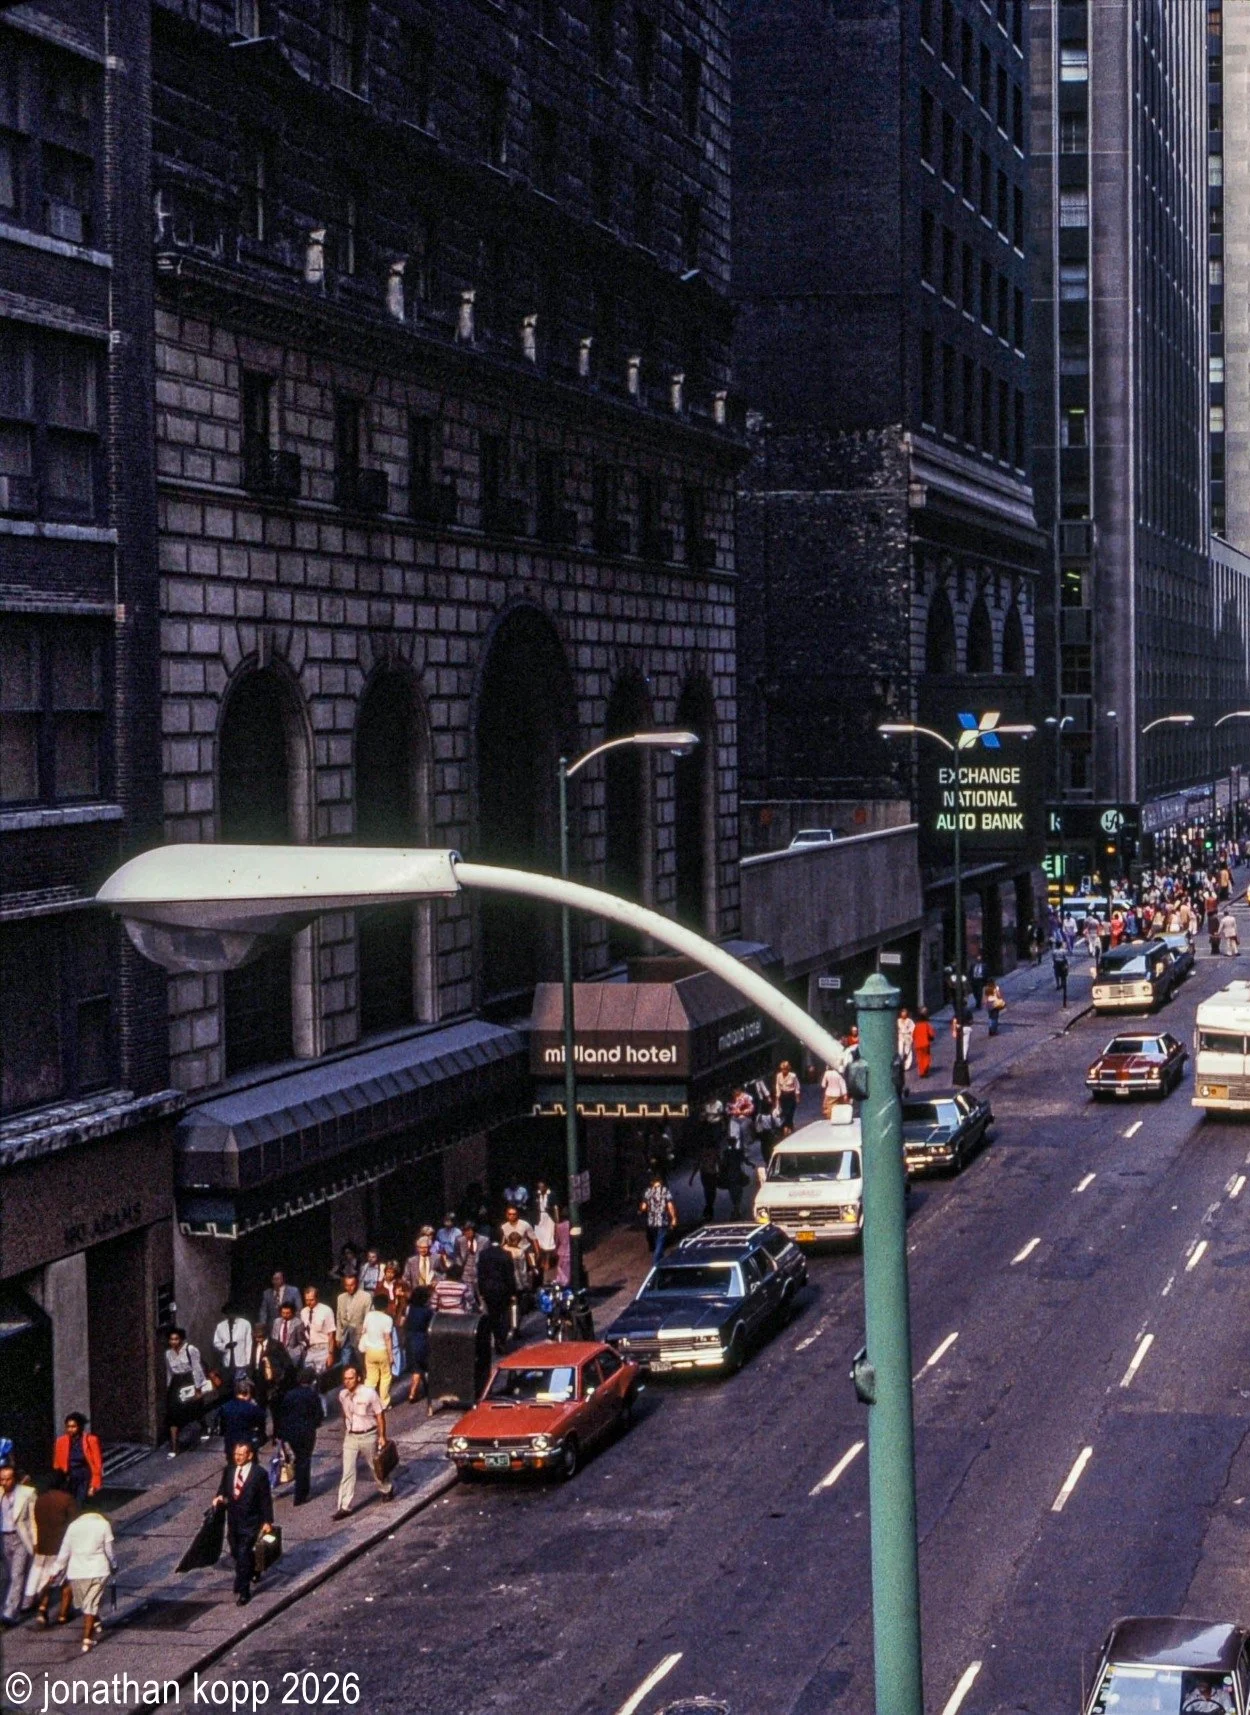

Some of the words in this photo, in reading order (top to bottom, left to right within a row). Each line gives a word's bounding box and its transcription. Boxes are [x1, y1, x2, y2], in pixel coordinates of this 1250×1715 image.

[938, 767, 1021, 784] EXCHANGE
[936, 812, 976, 830] AUTO
[981, 812, 1024, 830] BANK
[626, 1044, 677, 1063] hotel
